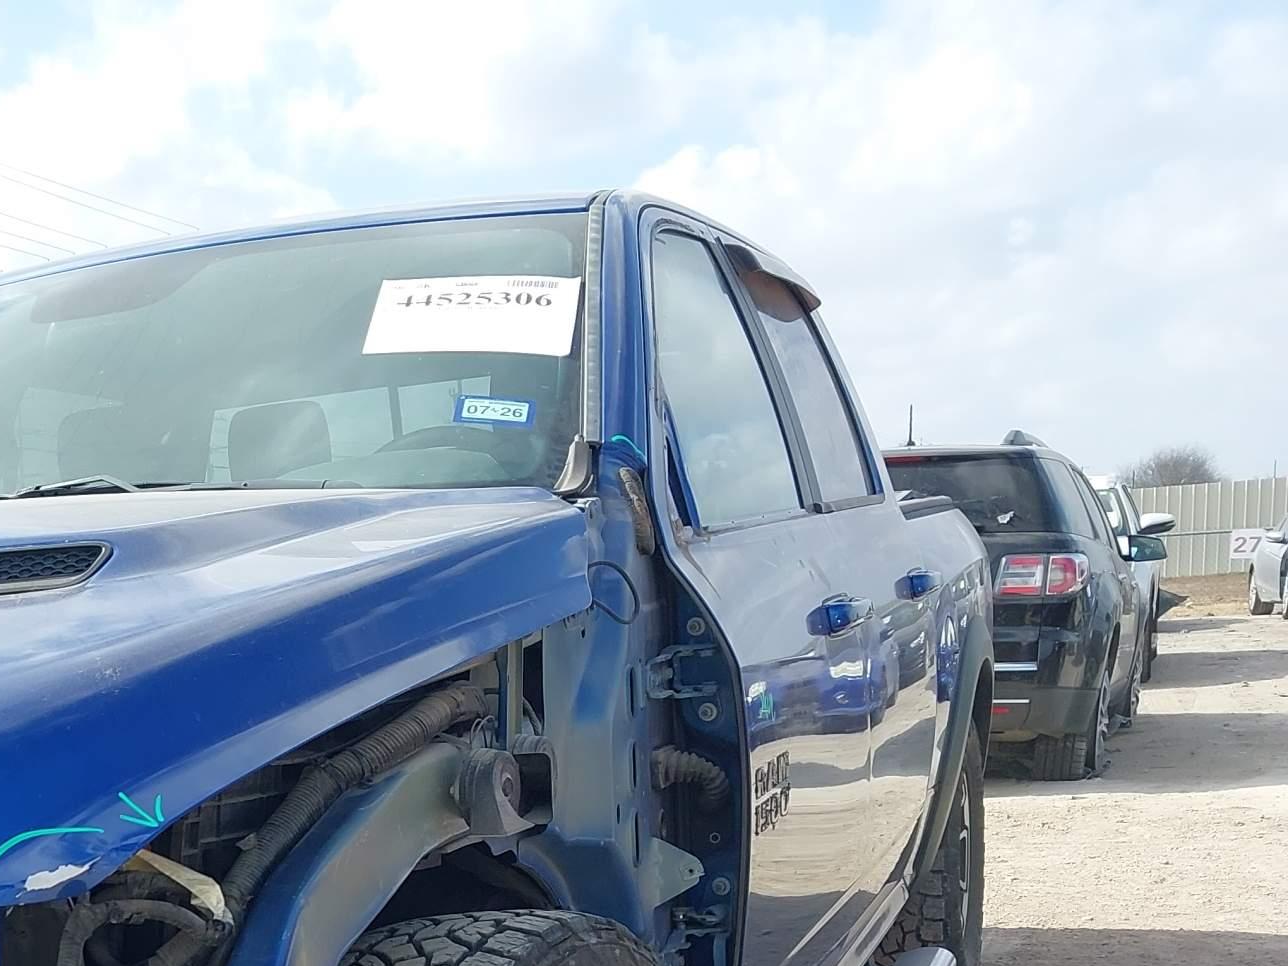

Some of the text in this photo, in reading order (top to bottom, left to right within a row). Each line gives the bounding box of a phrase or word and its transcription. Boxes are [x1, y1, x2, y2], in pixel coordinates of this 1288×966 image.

[396, 291, 553, 308] 44525306
[1233, 536, 1262, 553] 27
[754, 750, 790, 800] RAM
[754, 783, 791, 836] 1500
